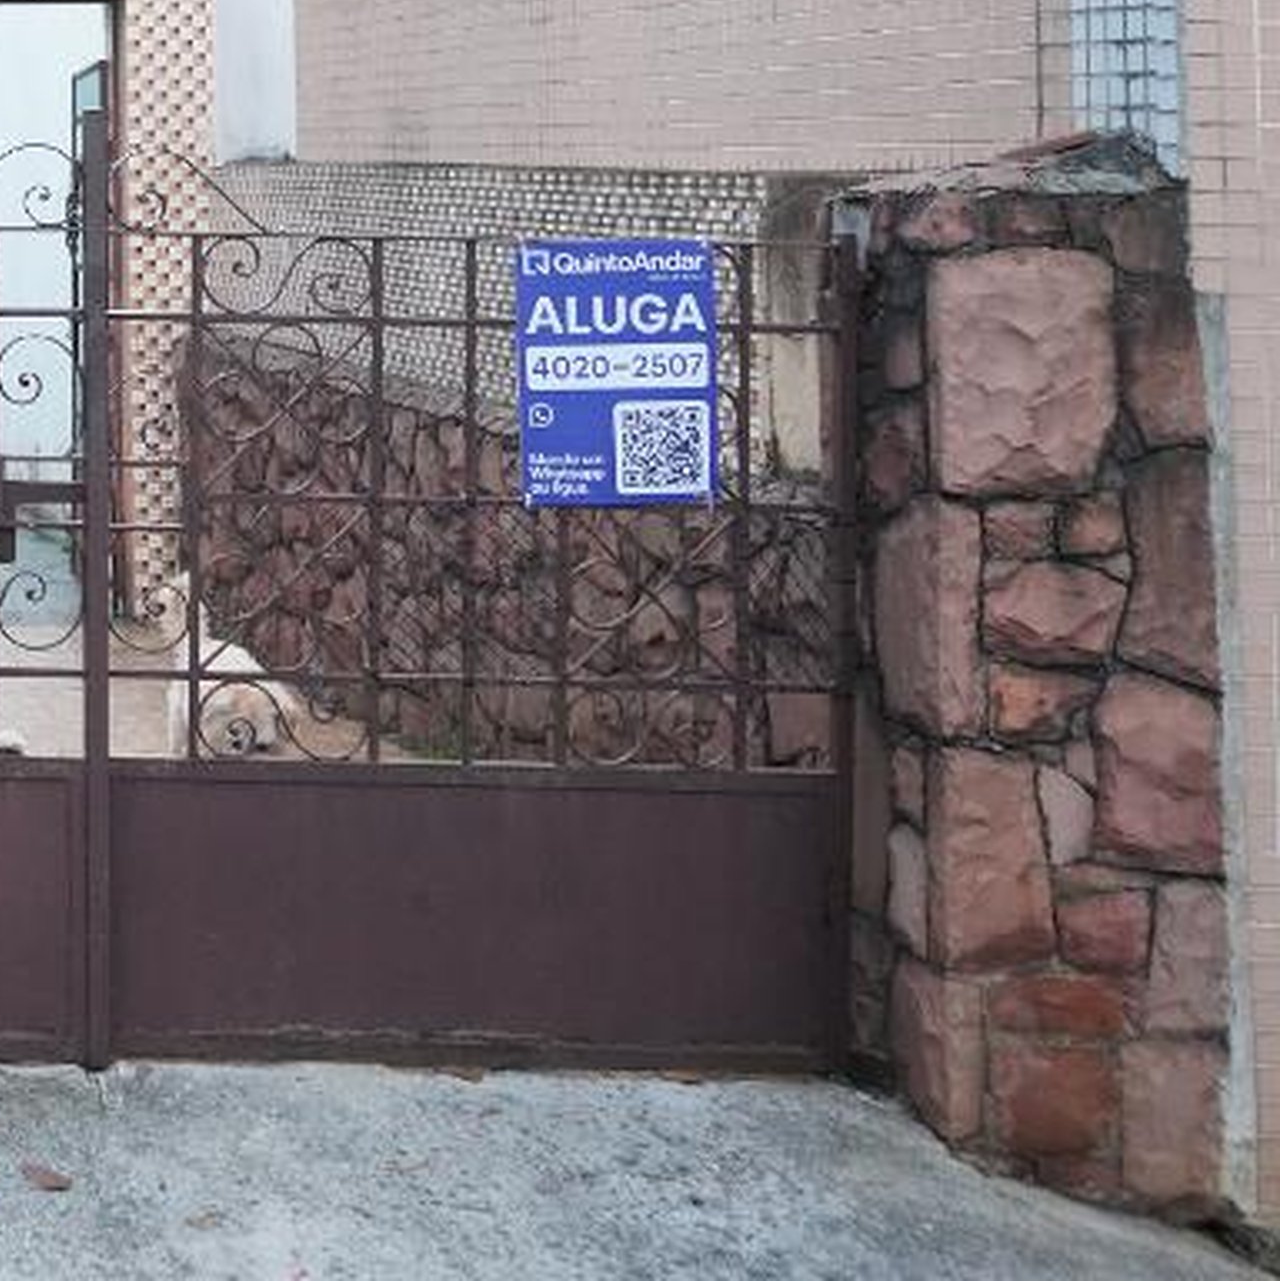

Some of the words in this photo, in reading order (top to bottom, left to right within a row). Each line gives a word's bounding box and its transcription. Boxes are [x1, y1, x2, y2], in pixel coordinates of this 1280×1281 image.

[553, 250, 706, 274] QuintoAndar
[525, 293, 707, 335] ALUGA
[531, 353, 704, 379] 4020-2507
